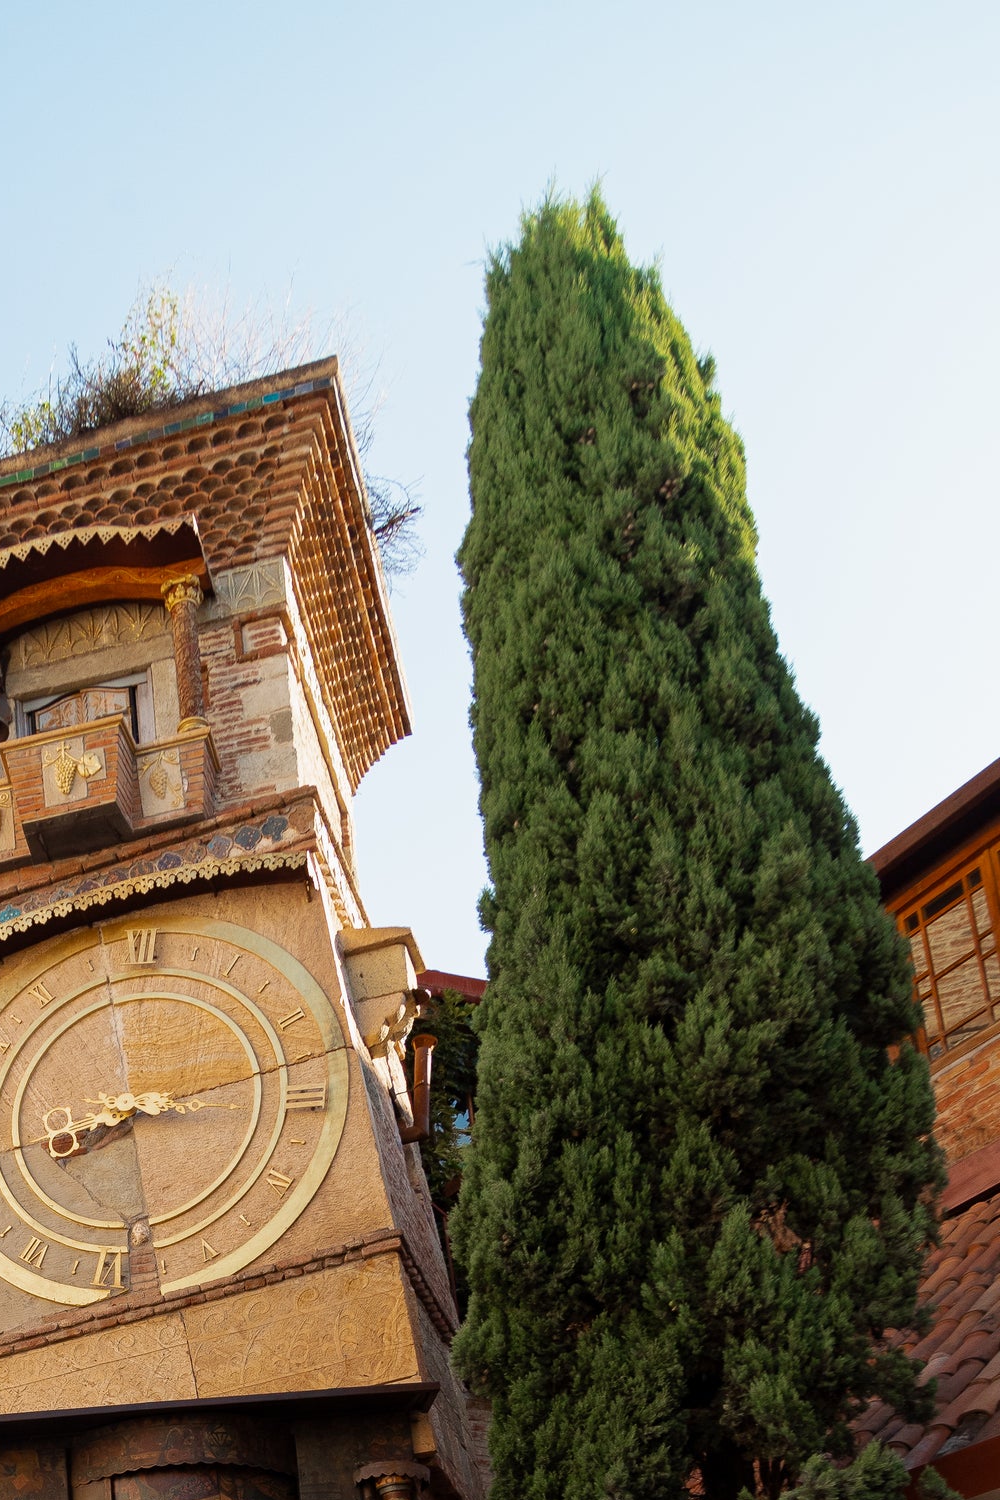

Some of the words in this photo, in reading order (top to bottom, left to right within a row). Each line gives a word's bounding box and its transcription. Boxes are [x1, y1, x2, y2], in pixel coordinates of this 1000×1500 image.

[121, 927, 160, 965] XII
[222, 952, 242, 978] I
[28, 981, 56, 1010] XI
[277, 1007, 306, 1030] II
[285, 1080, 327, 1110] III
[266, 1168, 296, 1199] IV
[18, 1235, 49, 1269] VII
[202, 1238, 221, 1263] V
[90, 1246, 125, 1289] VI
